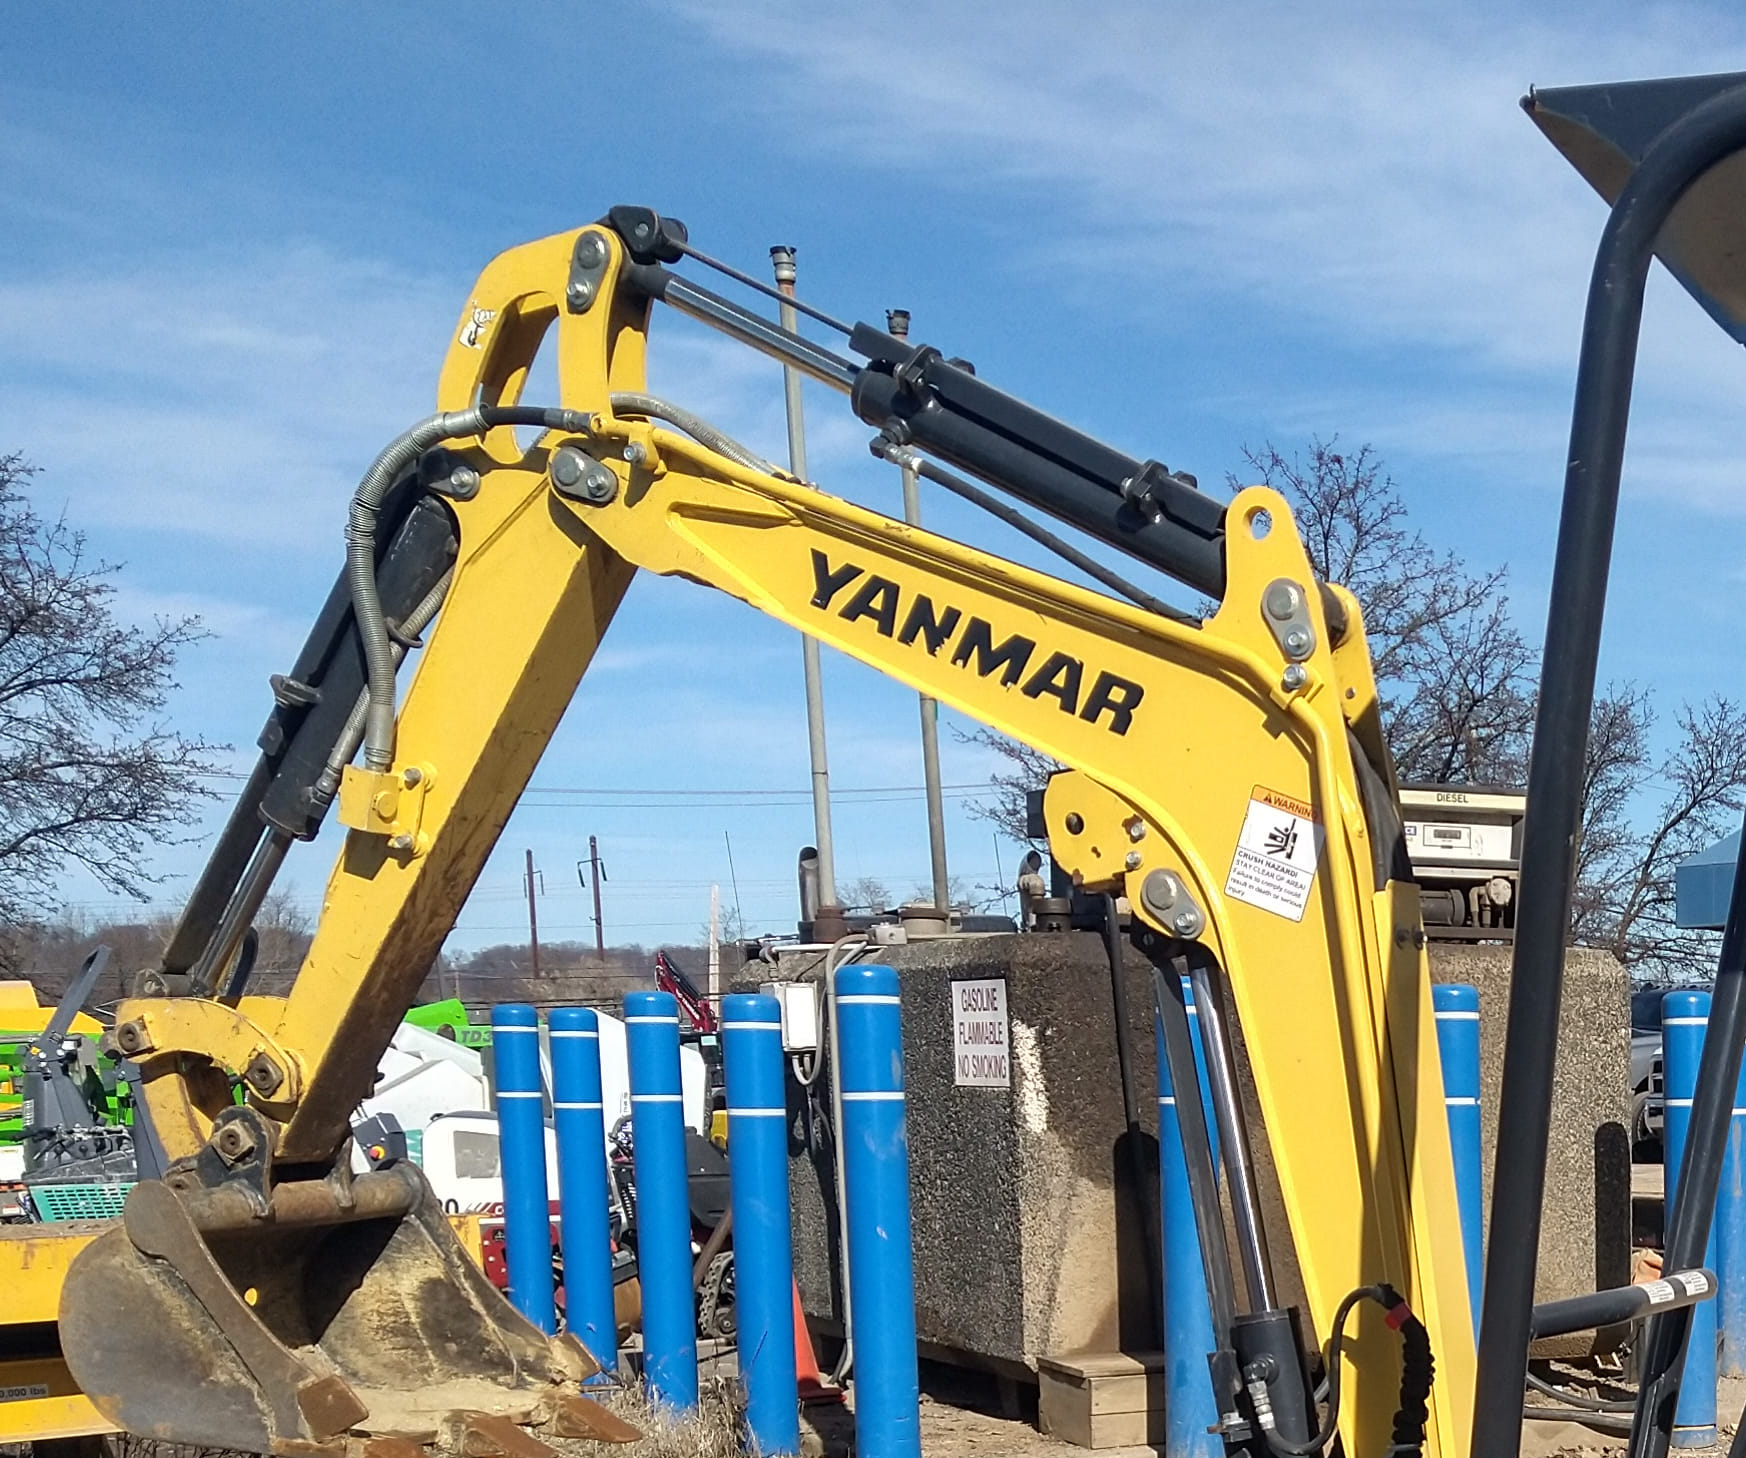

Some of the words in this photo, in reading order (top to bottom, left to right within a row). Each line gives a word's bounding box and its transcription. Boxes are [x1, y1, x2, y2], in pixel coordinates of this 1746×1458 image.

[809, 547, 1145, 736] YANMAR
[1436, 793, 1469, 803] DIESEL
[1238, 851, 1264, 865] CRUSH
[961, 987, 998, 1012] GASOLINE
[959, 1021, 1003, 1044] FLAMMABLE
[958, 1054, 969, 1078] NO
[971, 1054, 1007, 1079] SMOKING
